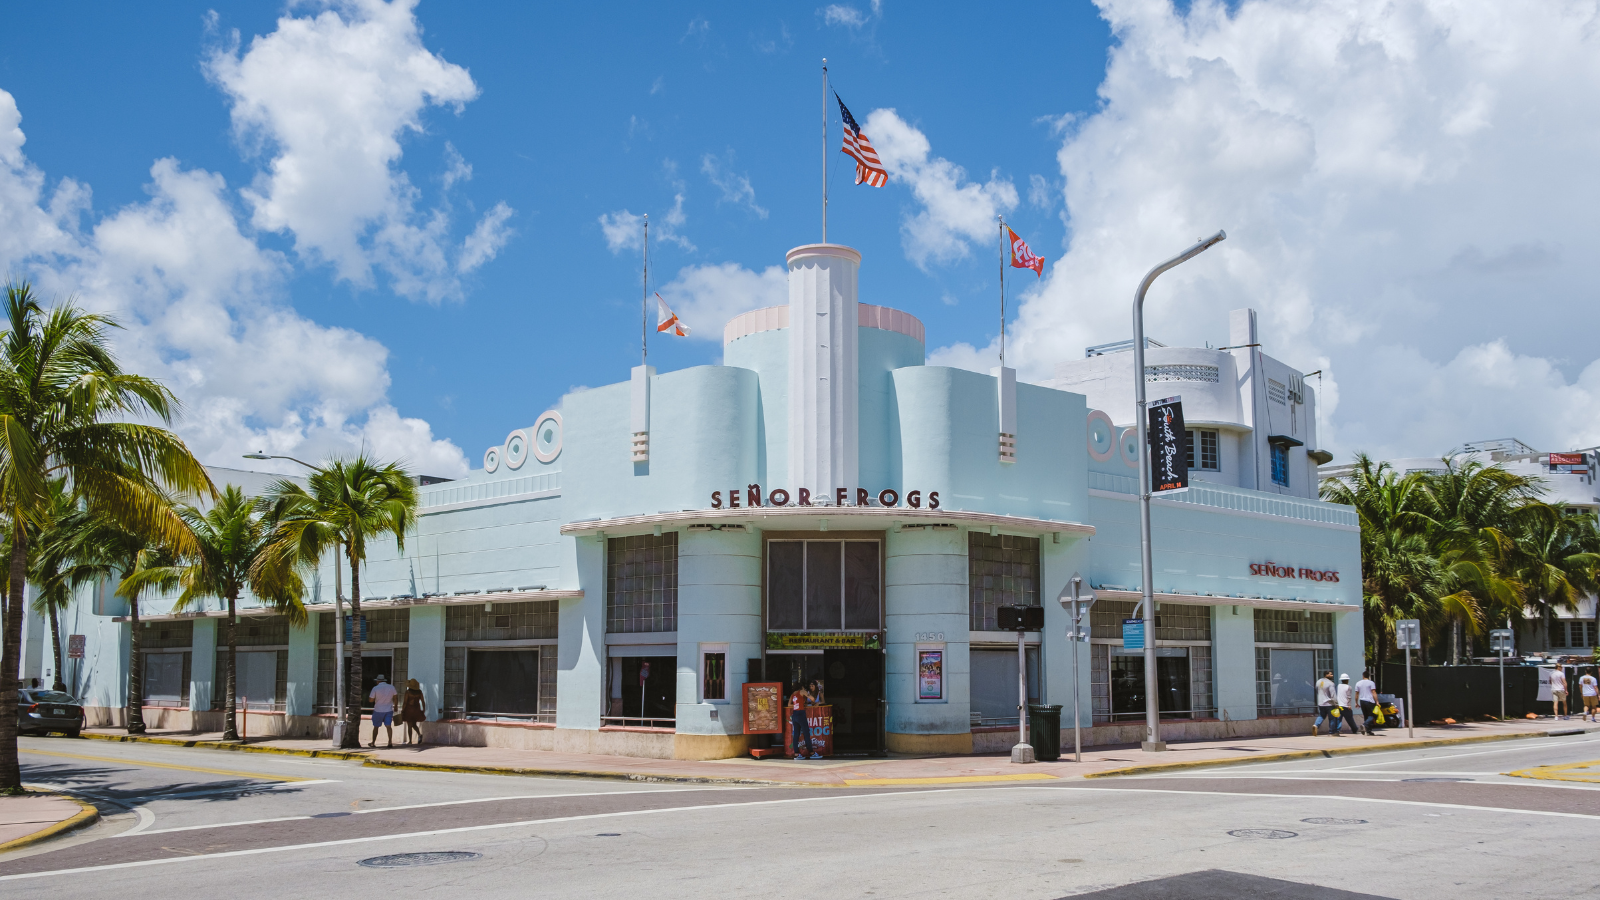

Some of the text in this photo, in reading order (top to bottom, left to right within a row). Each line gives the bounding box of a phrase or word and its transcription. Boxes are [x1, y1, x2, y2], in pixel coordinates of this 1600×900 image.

[1161, 406, 1176, 442] South
[1165, 443, 1178, 480] Beach
[1160, 483, 1176, 491] APRIL
[711, 484, 940, 509] SEÑOR FROGS
[1249, 561, 1340, 583] SEÑOR FROGS
[915, 632, 944, 641] 1450
[807, 716, 823, 727] HAT
[808, 726, 830, 737] ROG
